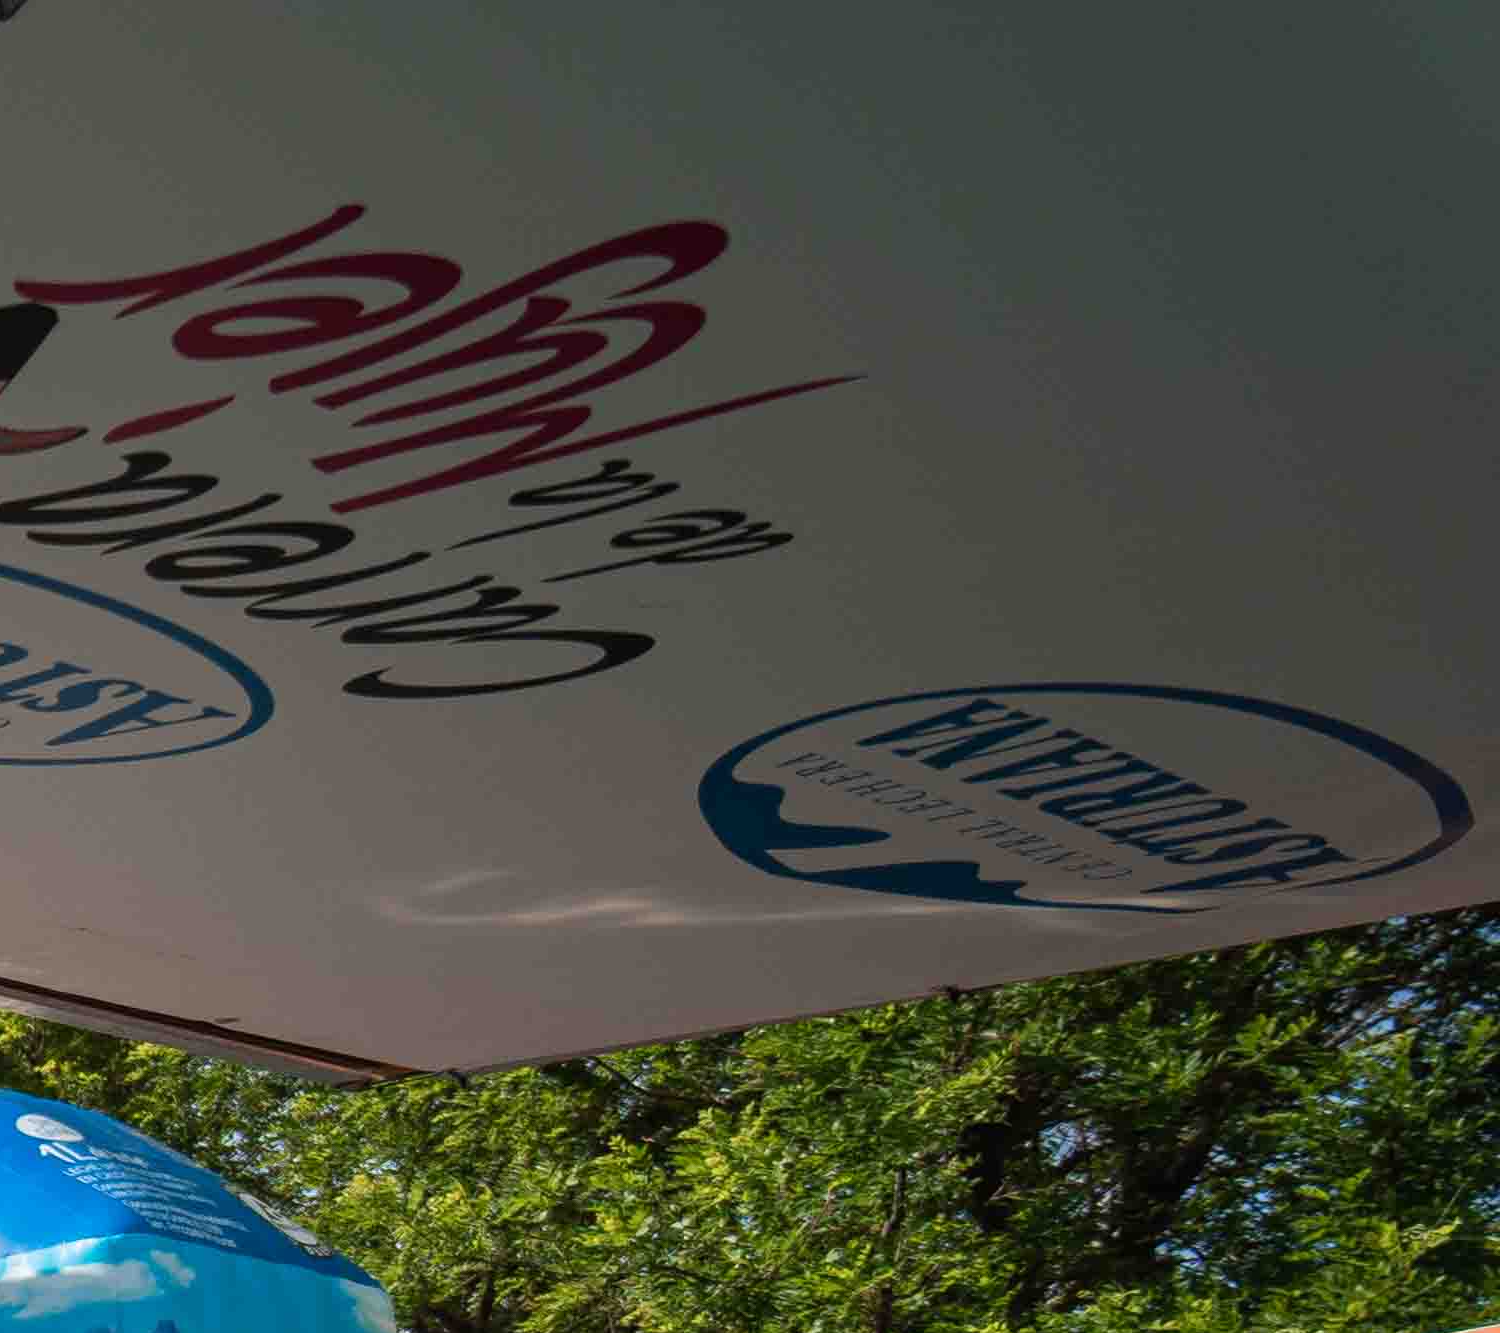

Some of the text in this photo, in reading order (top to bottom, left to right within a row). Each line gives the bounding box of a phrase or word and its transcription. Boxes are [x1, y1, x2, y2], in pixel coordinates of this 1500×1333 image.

[14, 203, 869, 515] Mujer
[444, 458, 795, 584] de la
[776, 750, 1133, 882] CENTRAL LECHERA
[855, 697, 1357, 895] ASTURIANA
